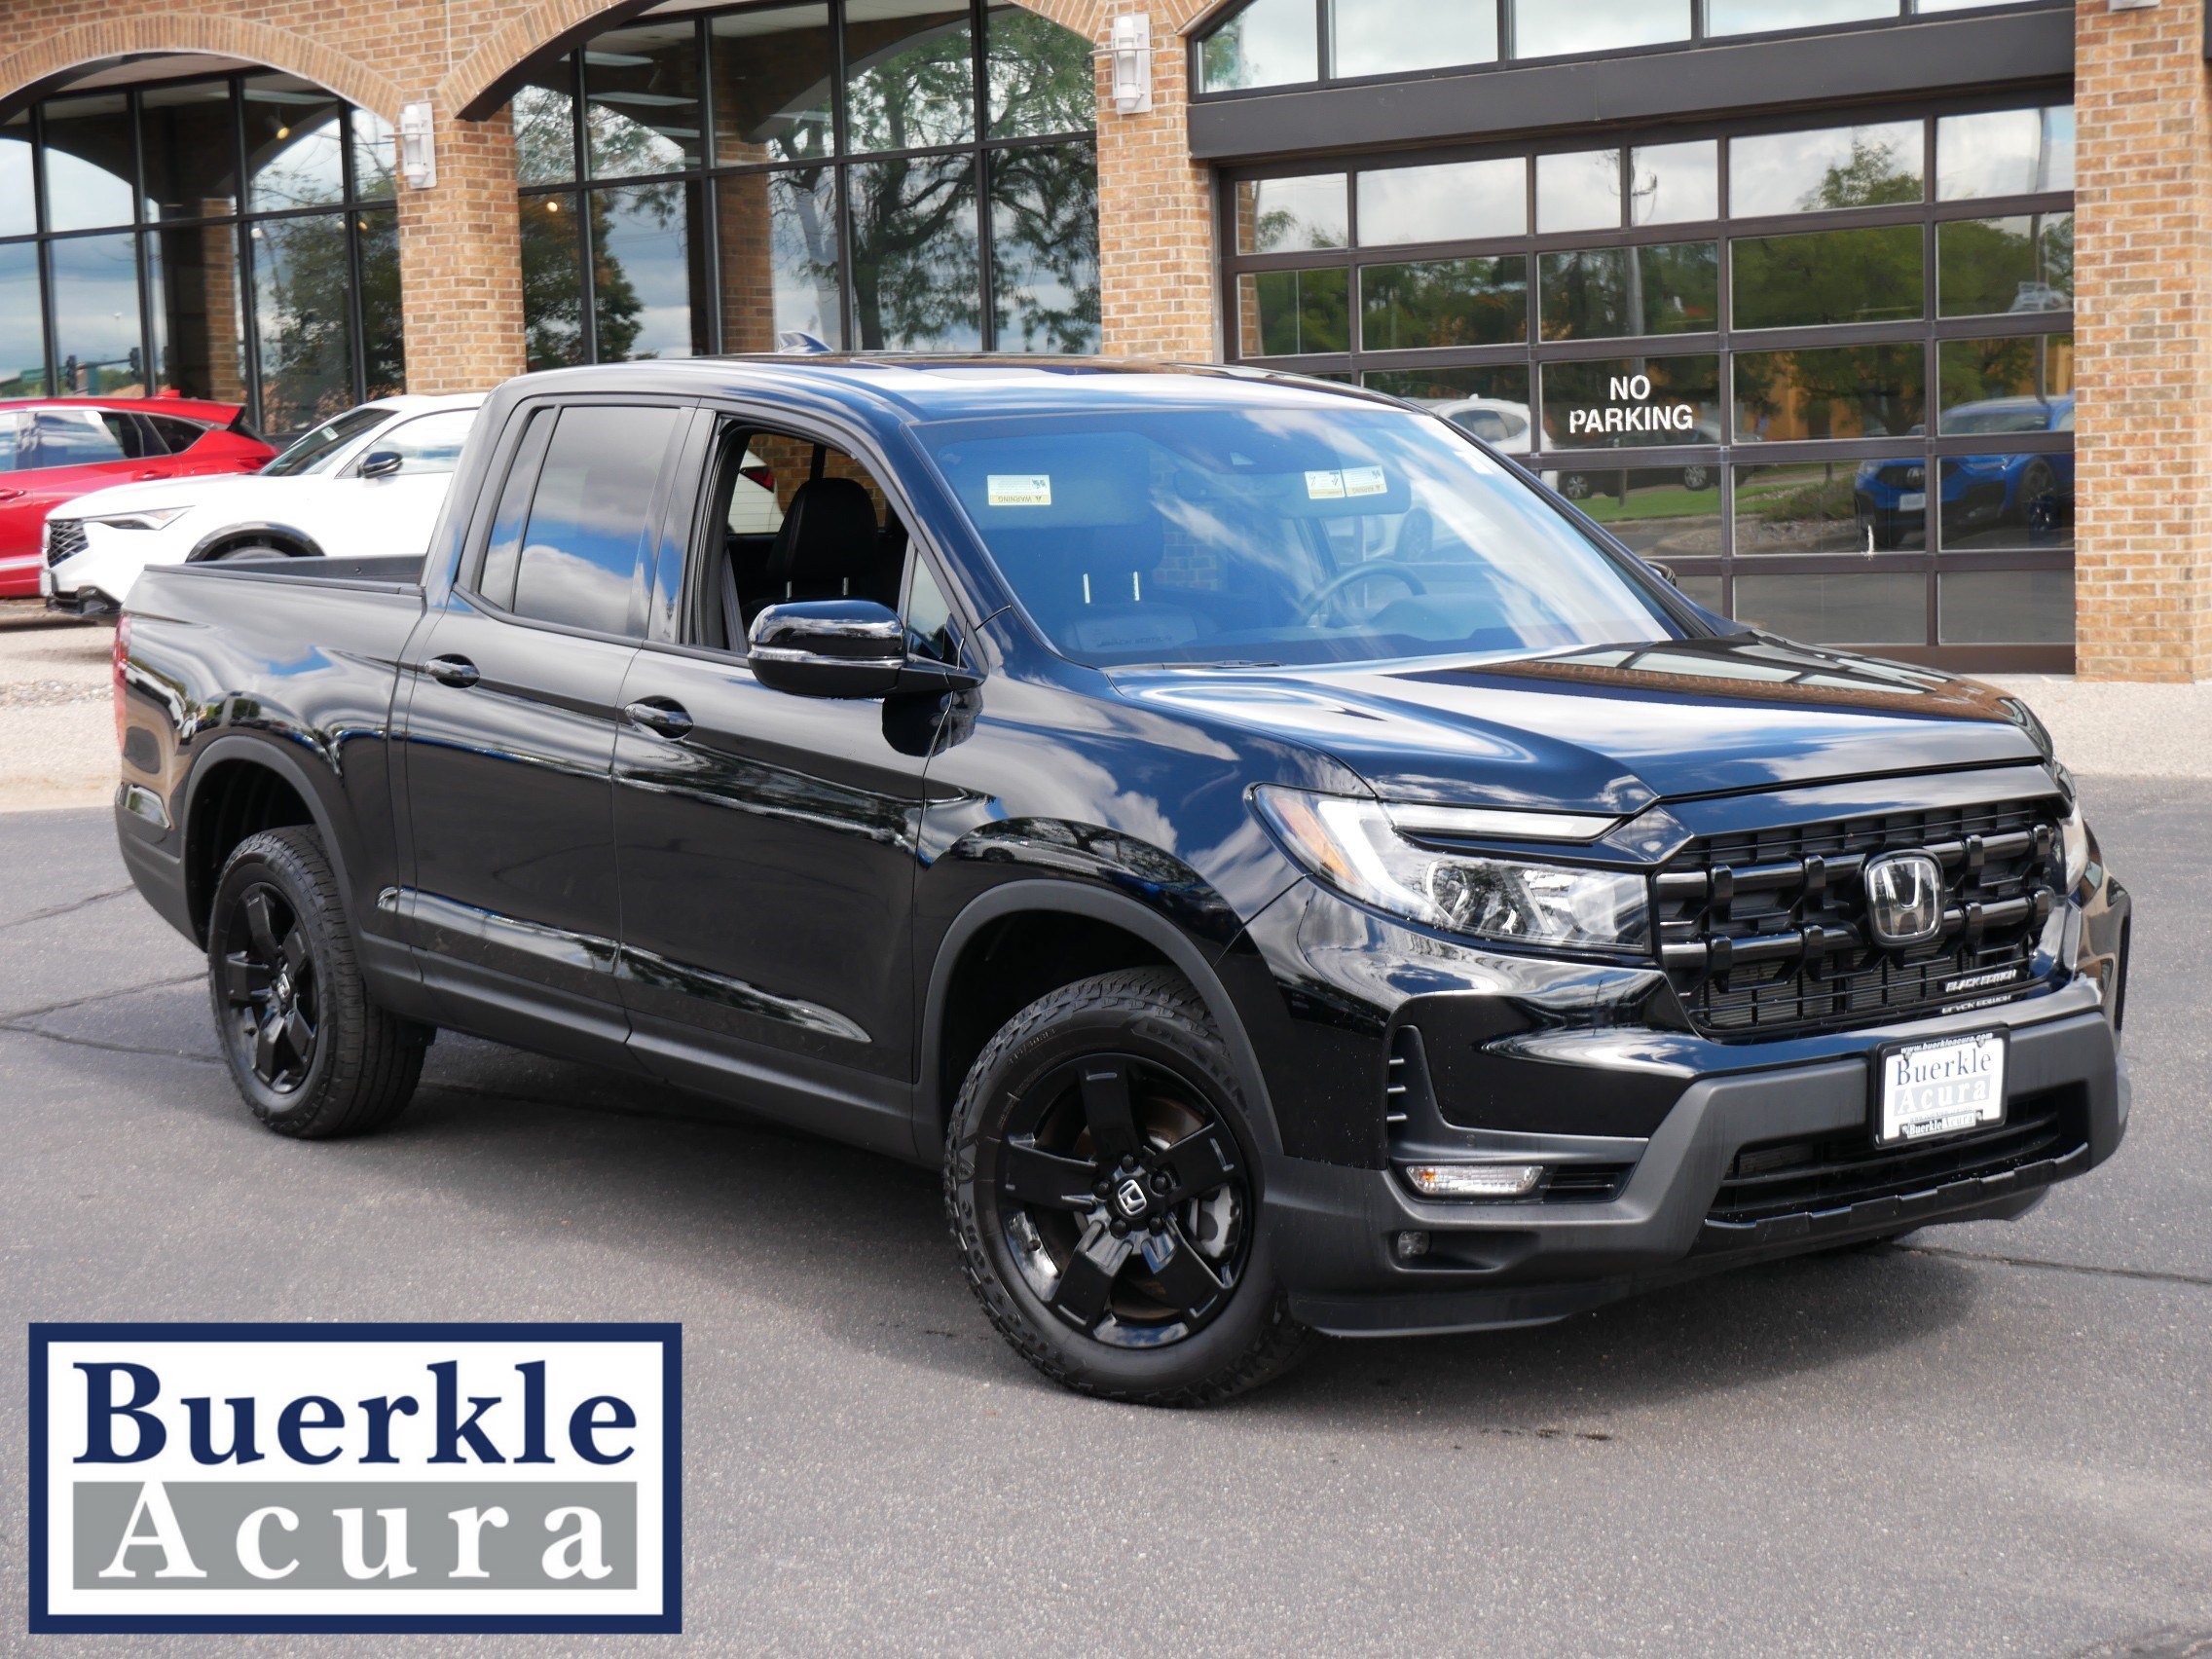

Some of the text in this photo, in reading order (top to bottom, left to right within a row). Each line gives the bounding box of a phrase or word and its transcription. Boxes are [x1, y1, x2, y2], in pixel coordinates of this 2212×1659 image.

[1609, 374, 1651, 401] NO
[1568, 404, 1694, 434] PARKING
[998, 495, 1032, 503] WARNING
[1945, 969, 2017, 992] BLACK EDITION
[1900, 1032, 1993, 1054] www.buerkleacura.com
[1896, 1049, 1991, 1087] Buerkle
[1897, 1080, 1987, 1115] Acura
